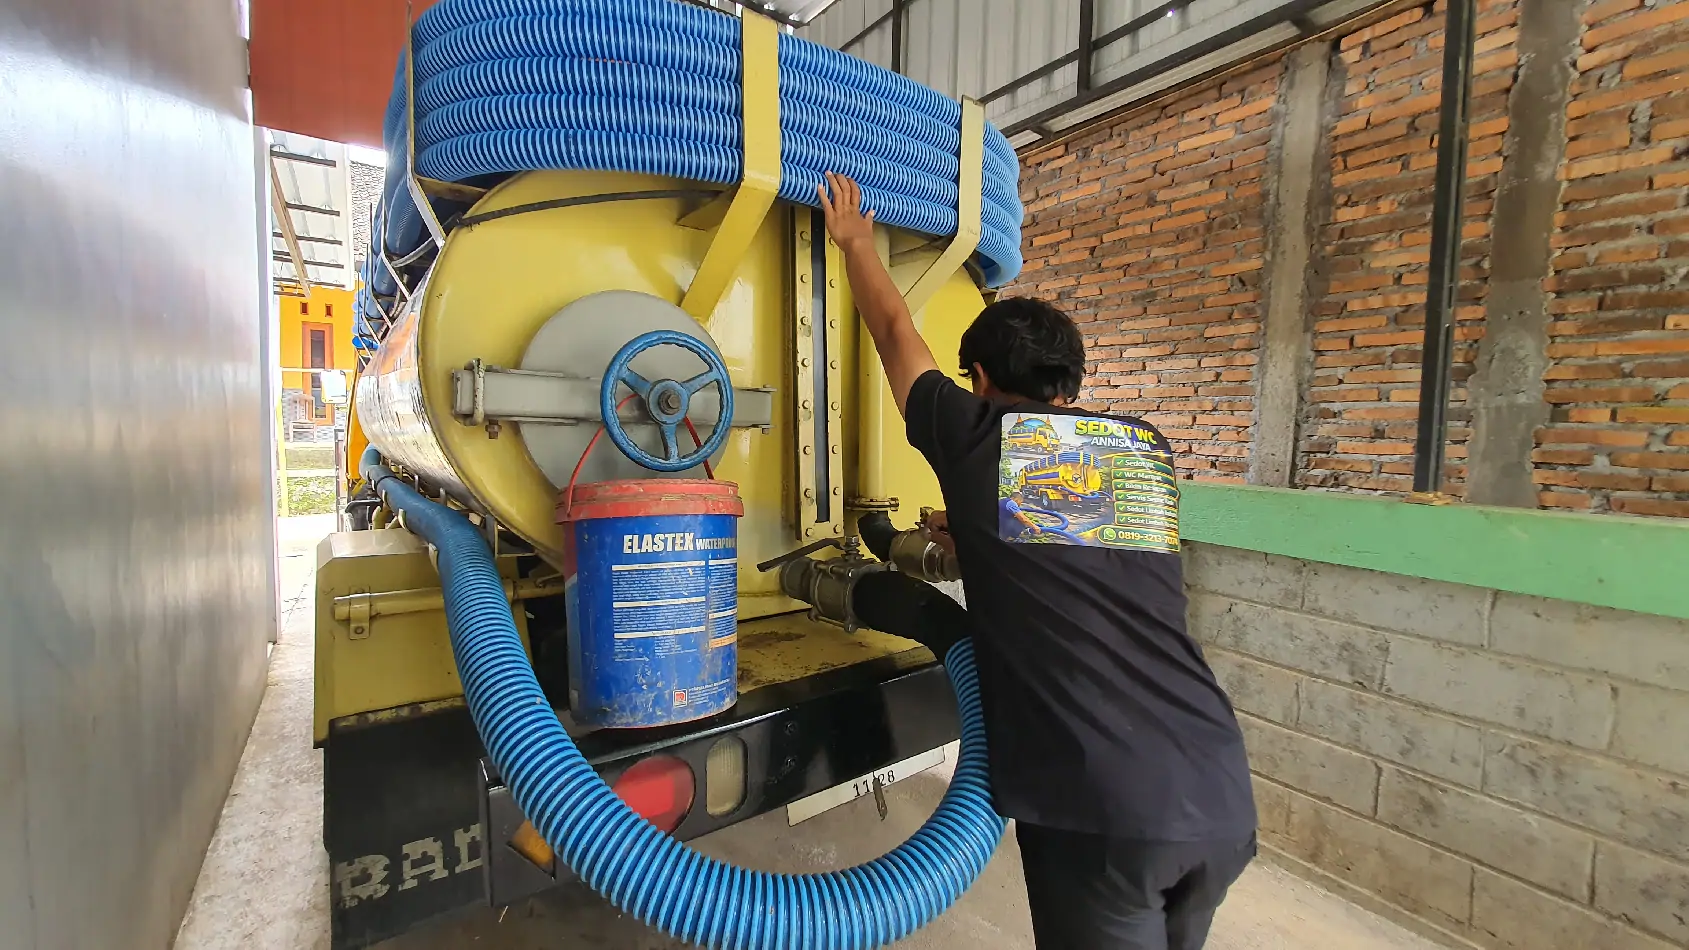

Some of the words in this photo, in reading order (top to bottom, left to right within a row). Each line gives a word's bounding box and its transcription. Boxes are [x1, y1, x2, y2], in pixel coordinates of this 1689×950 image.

[1075, 419, 1133, 439] SEDOT
[1134, 427, 1157, 445] WC
[1091, 436, 1131, 448] ANNISA
[1132, 440, 1152, 452] JAYA
[623, 532, 695, 554] ELASTEX
